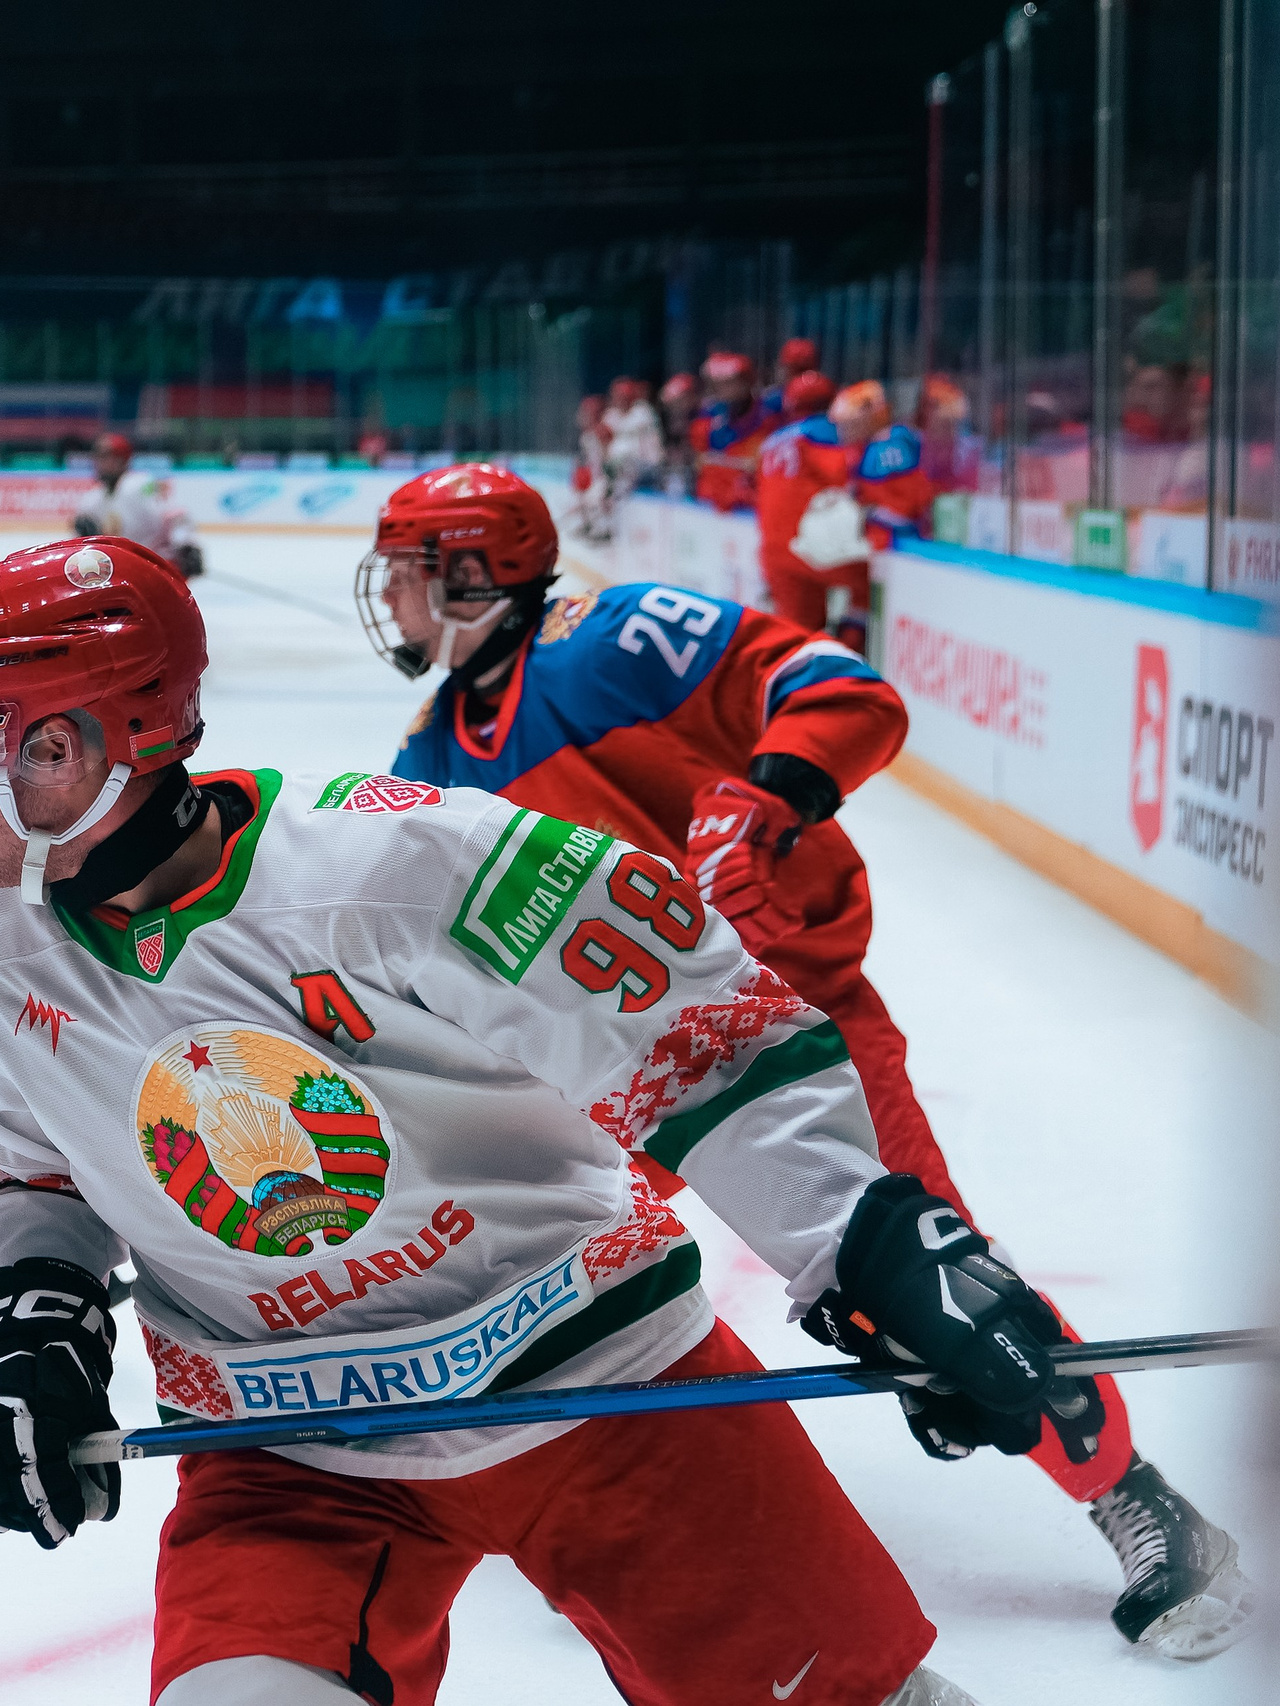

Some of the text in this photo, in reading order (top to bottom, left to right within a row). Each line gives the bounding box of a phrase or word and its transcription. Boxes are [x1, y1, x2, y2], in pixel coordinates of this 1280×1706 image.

[440, 527, 486, 541] CCM
[617, 586, 721, 678] 29
[1177, 694, 1275, 810] СПОРТ
[503, 825, 607, 954] ЛИГА СТАВО
[560, 851, 706, 1013] 98
[290, 969, 376, 1044] A
[260, 1198, 344, 1233] РЭСПУБЛІКА
[275, 1213, 347, 1246] БЕЛАРУСЬ
[247, 1199, 475, 1332] BELARUS
[234, 1257, 578, 1411] BELARUSKALI
[821, 1306, 846, 1349] CCM
[994, 1332, 1039, 1379] CCM
[635, 1376, 725, 1390] TRIGGER
